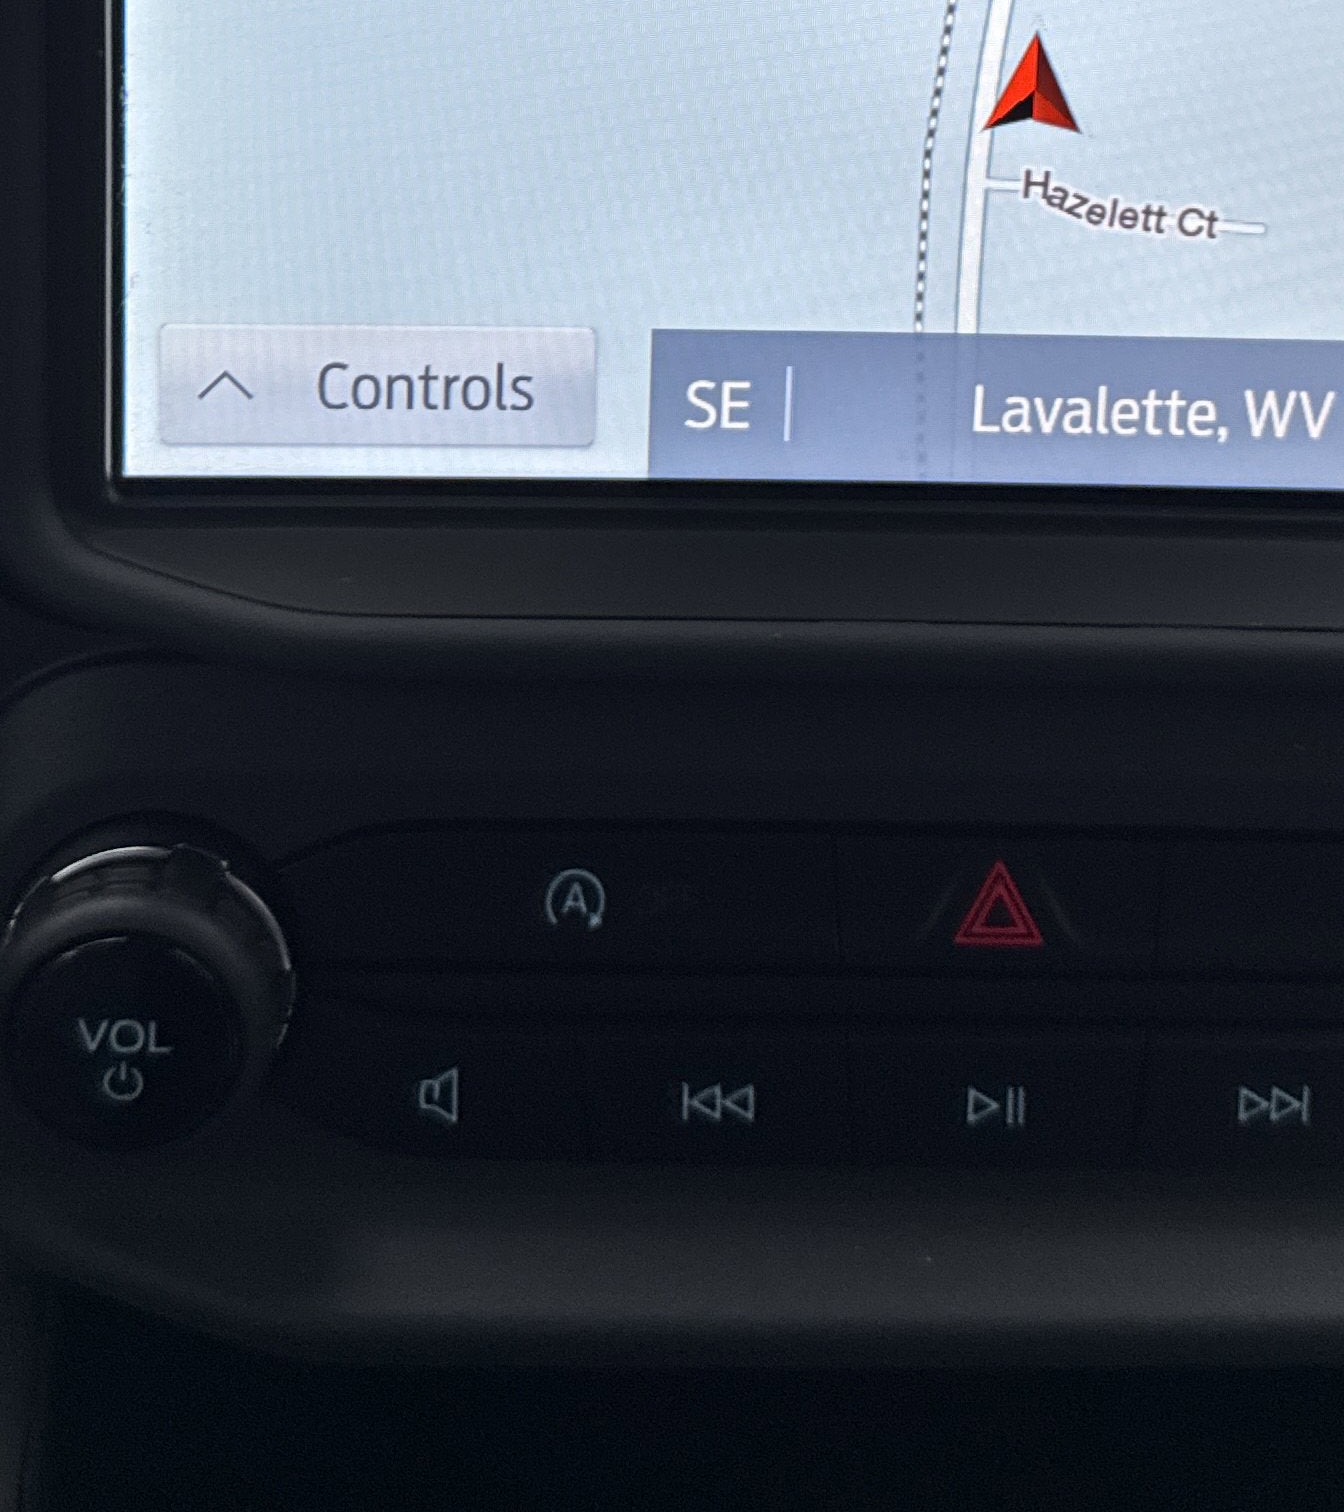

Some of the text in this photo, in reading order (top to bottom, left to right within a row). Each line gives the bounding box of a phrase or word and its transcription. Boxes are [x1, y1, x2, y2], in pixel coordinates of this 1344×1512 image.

[1022, 168, 1218, 239] Hazelett Ct
[317, 362, 535, 412] Controls
[684, 379, 751, 430] SE
[972, 384, 1336, 443] Lavalette, WV
[78, 1018, 173, 1054] VOL
